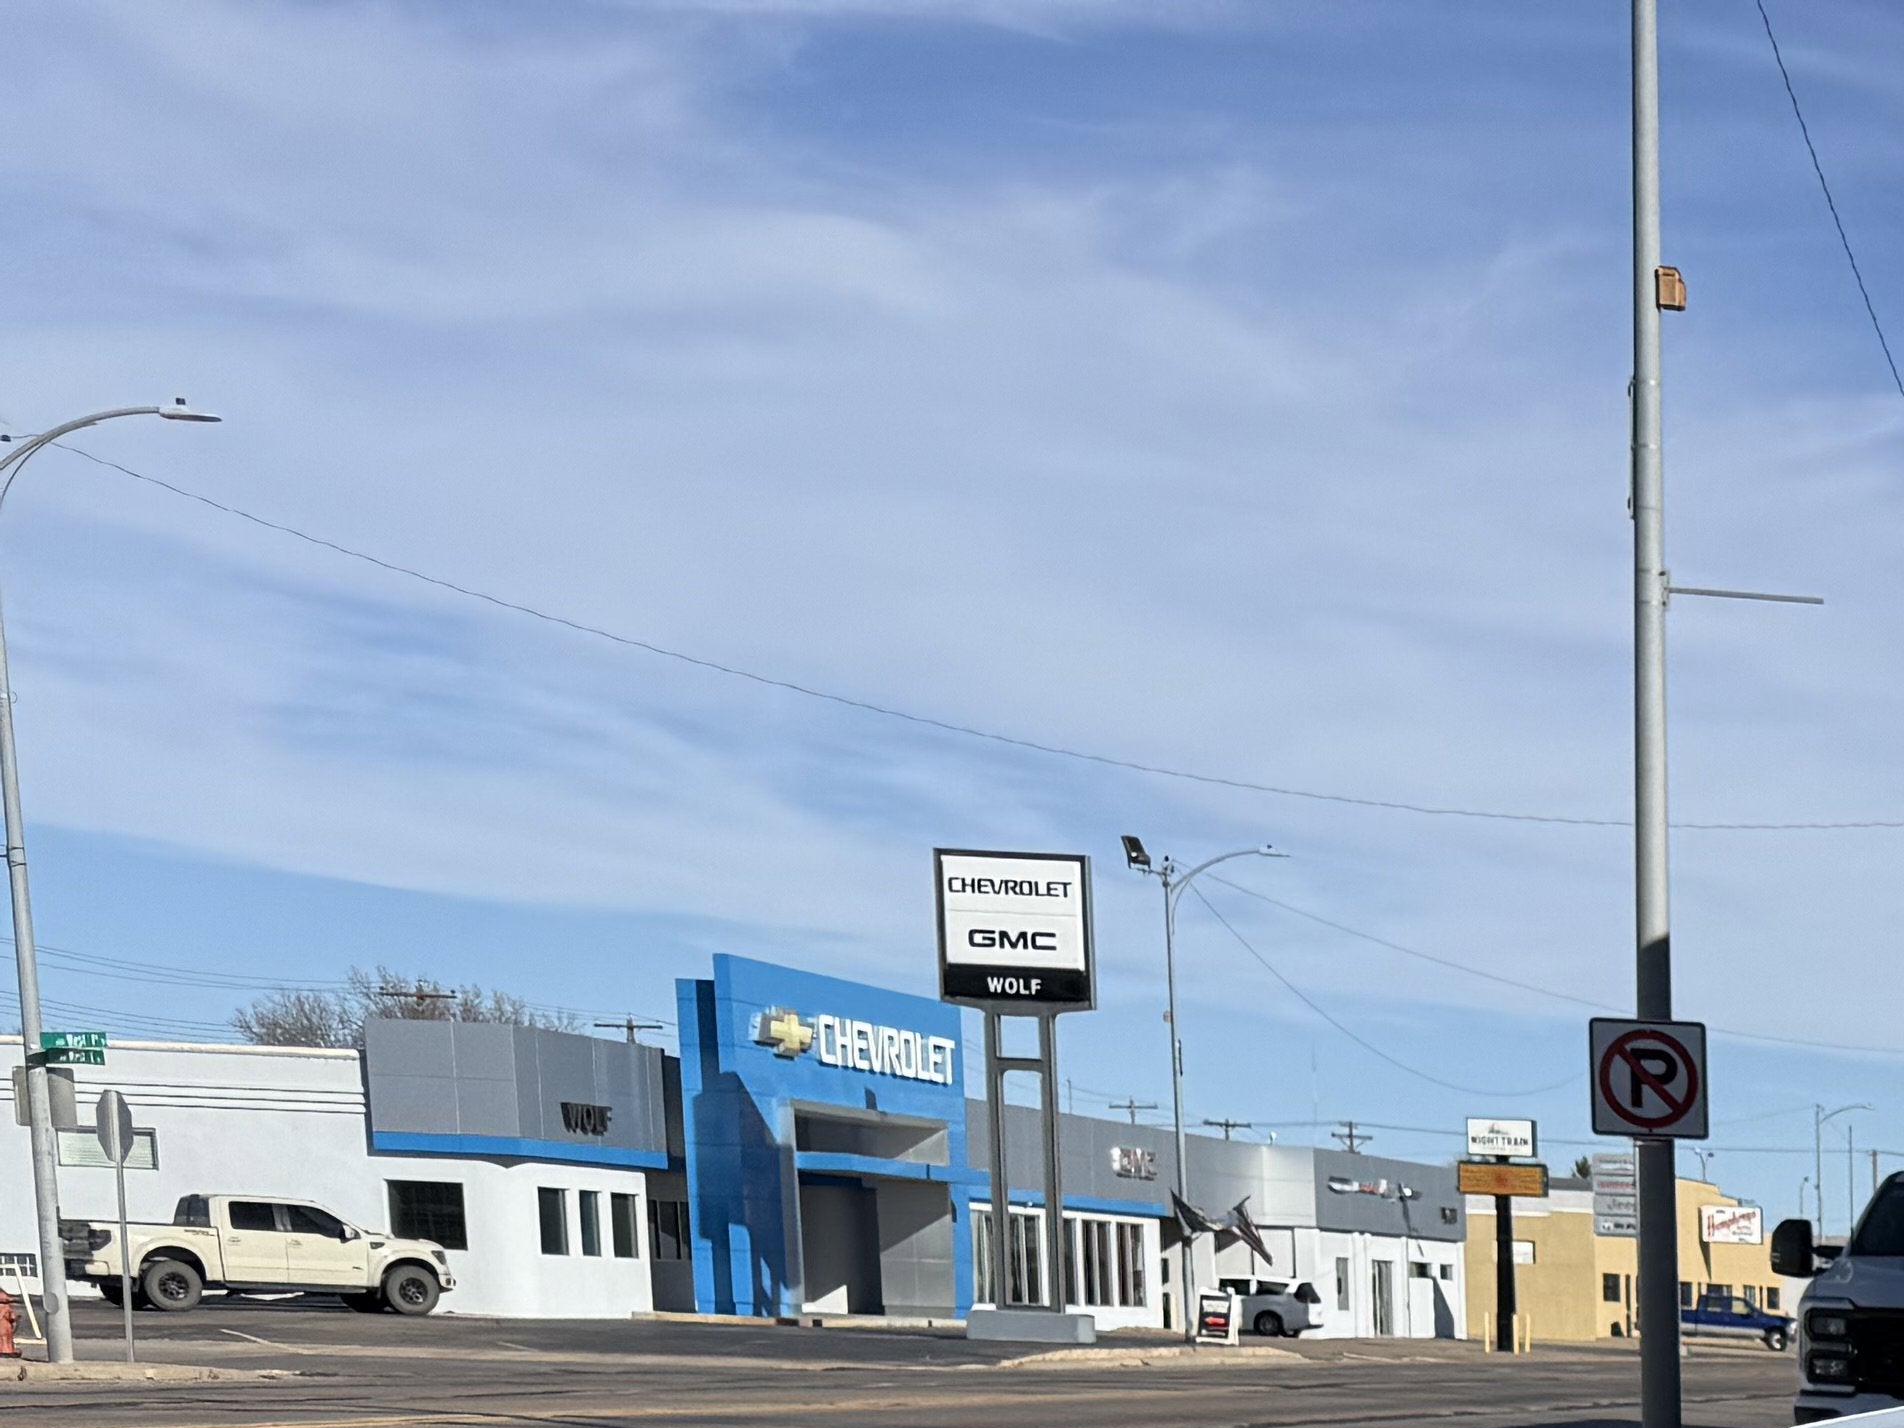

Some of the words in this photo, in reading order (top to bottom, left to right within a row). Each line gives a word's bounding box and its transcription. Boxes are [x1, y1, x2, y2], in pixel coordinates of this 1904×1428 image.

[948, 876, 1072, 898] CHEVROLET
[968, 929, 1057, 951] GMC
[987, 976, 1042, 995] WOLF
[818, 1014, 955, 1085] CHEVROLET
[560, 1102, 613, 1136] WOLF
